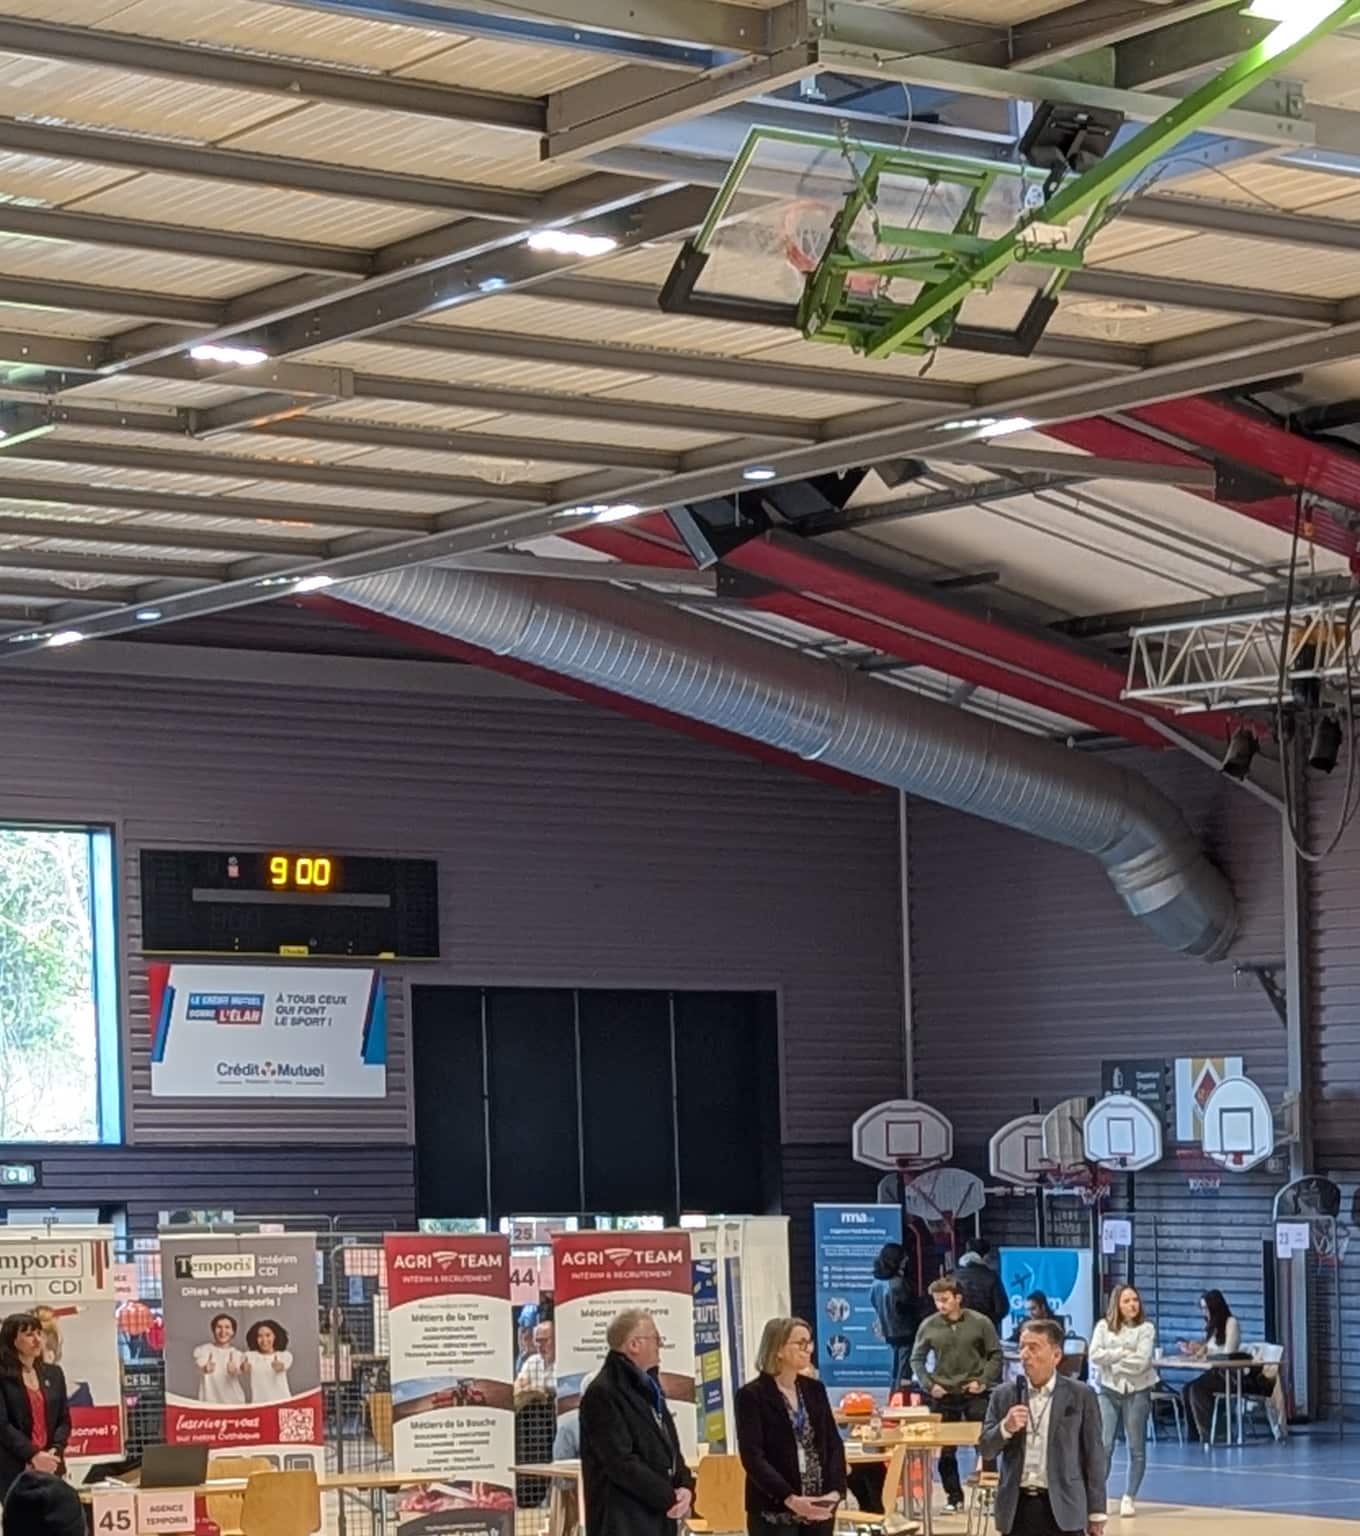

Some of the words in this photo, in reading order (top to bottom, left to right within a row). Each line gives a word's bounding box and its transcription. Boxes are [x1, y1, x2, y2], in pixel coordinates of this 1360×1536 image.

[276, 992, 284, 1004] À
[287, 994, 315, 1005] TOUS
[318, 995, 348, 1005] CEUX
[275, 1006, 295, 1016] QUI
[297, 1006, 326, 1016] FONT
[275, 1017, 287, 1027] LE
[290, 1017, 325, 1027] SPORT
[216, 1061, 260, 1077] Crédit
[277, 1063, 325, 1077] Mutuel
[514, 1228, 533, 1241] 25
[393, 1254, 433, 1269] AGRI
[458, 1254, 503, 1268] TEAM
[562, 1251, 605, 1266] AGRI
[633, 1249, 683, 1265] TEAM
[176, 1256, 252, 1276] Temporis
[258, 1266, 279, 1277] CDI
[440, 1274, 493, 1283] RECRUTEMENT
[510, 1268, 535, 1287] 44
[613, 1270, 672, 1280] RECRUTEMENT
[48, 1280, 82, 1295] CDI
[200, 1298, 225, 1308] avec
[226, 1297, 275, 1308] Temporis
[411, 1313, 444, 1323] Métiers
[445, 1313, 456, 1322] de
[457, 1313, 466, 1321] la
[468, 1312, 490, 1322] Terre
[410, 1420, 443, 1430] Métiers
[445, 1420, 455, 1429] de
[456, 1419, 465, 1428] la
[466, 1418, 497, 1428] Bouche
[149, 1503, 184, 1513] AGENCE
[99, 1509, 131, 1531] 45
[146, 1515, 188, 1526] TEMPORIS
